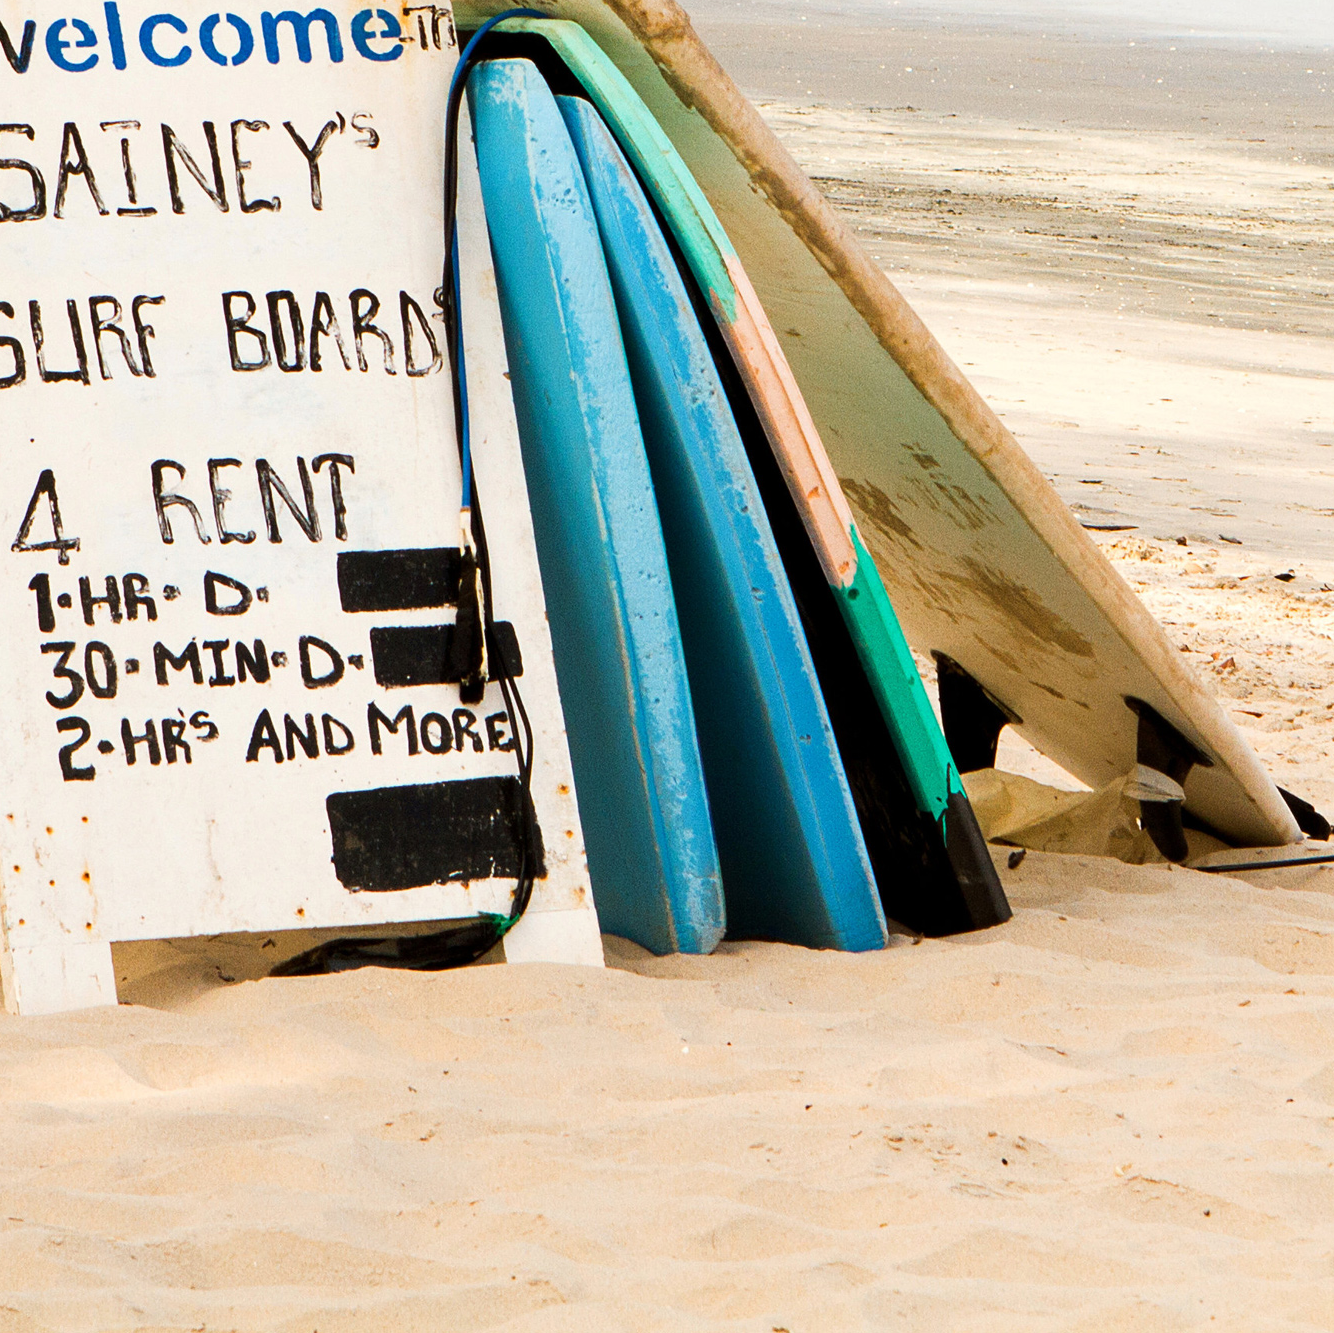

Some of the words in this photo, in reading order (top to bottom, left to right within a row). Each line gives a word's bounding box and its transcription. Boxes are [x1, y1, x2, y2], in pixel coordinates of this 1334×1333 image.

[10, 468, 81, 567] 4
[150, 452, 356, 546] RENT
[245, 708, 355, 765] AND
[367, 700, 516, 758] MORE
